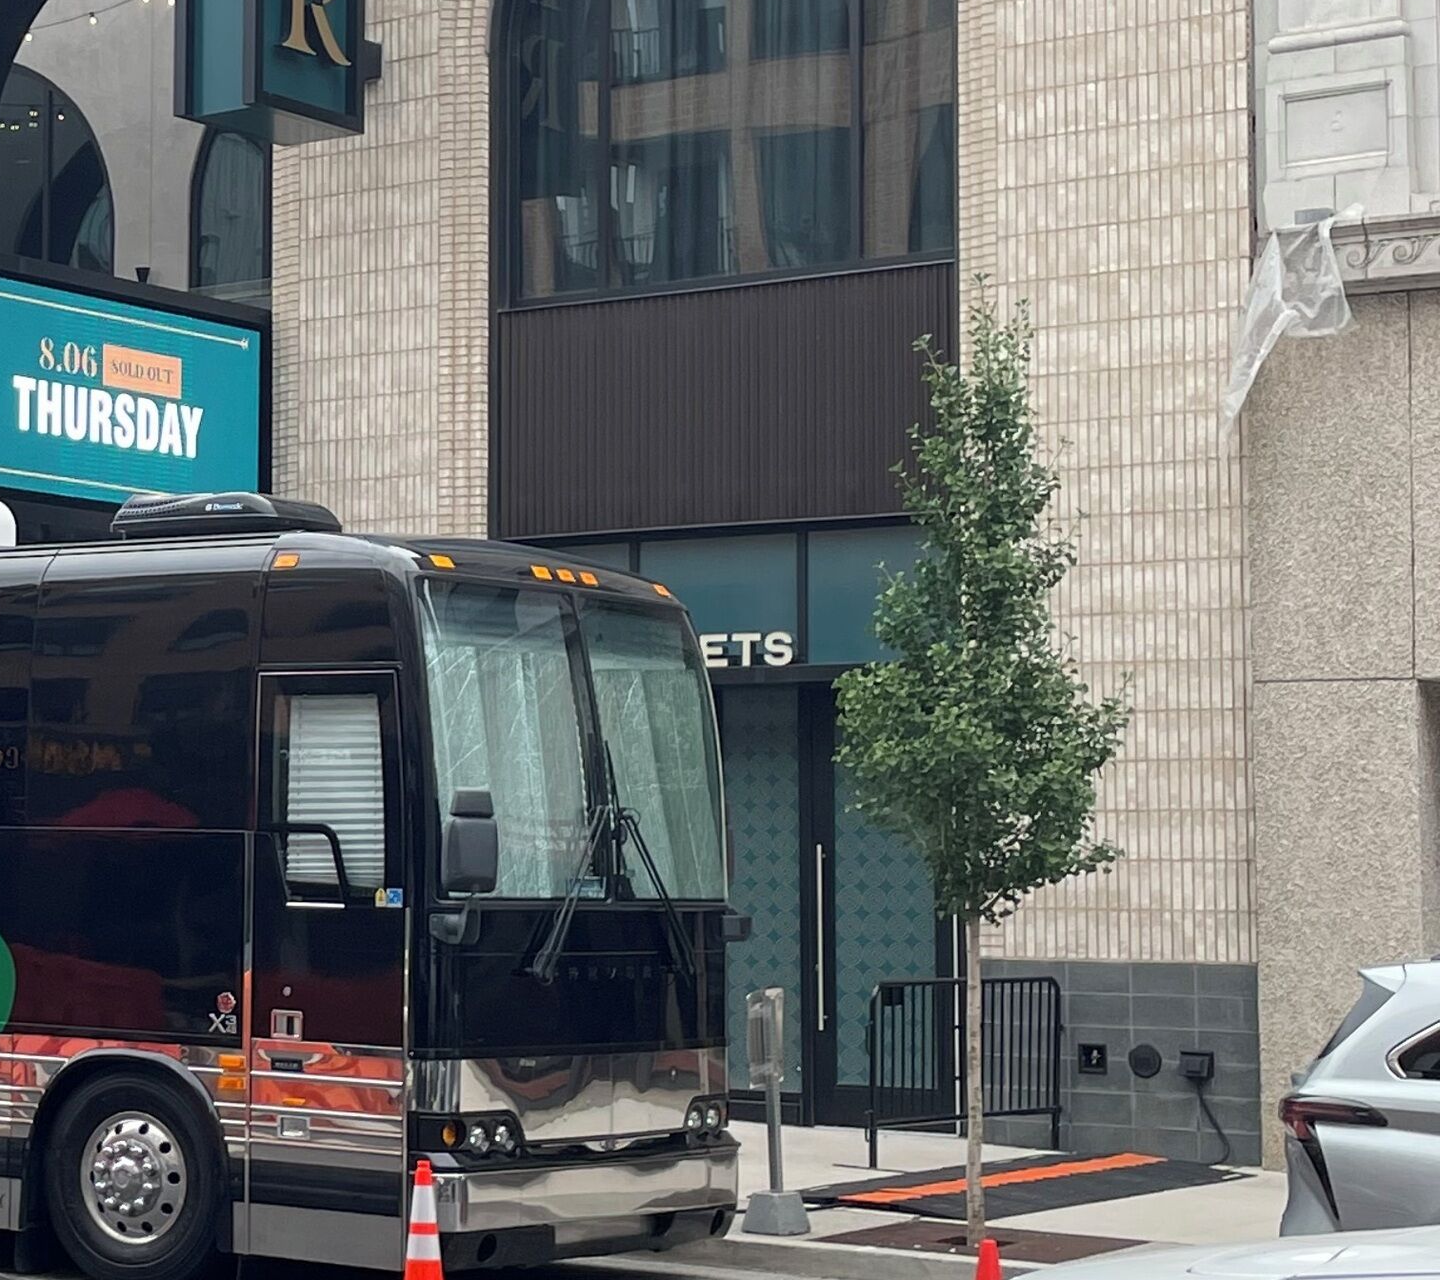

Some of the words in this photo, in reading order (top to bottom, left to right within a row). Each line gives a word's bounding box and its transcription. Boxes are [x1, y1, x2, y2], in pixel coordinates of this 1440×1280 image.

[39, 336, 98, 378] 8.06
[112, 359, 144, 379] SOLD
[147, 368, 173, 385] OUT
[13, 374, 204, 459] THURSDAY
[699, 631, 793, 667] ETS
